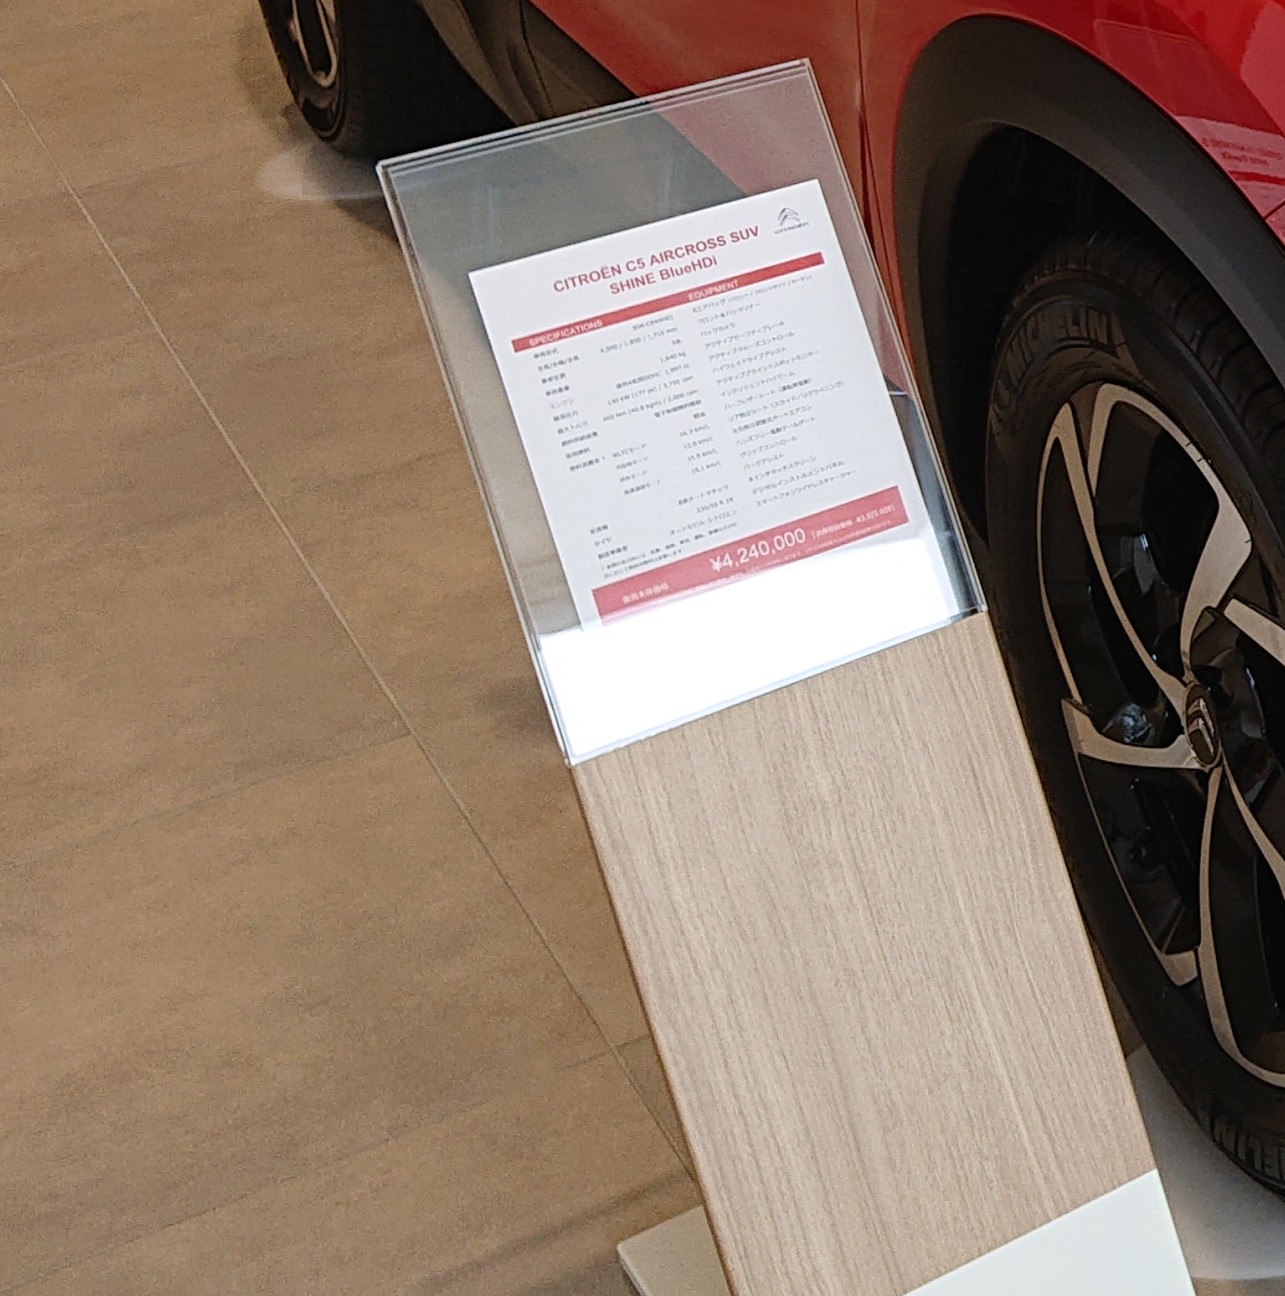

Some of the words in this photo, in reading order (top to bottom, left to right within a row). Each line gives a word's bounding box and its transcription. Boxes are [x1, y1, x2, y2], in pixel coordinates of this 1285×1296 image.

[551, 261, 622, 292] CITROËN
[624, 256, 646, 272] C5
[647, 234, 726, 266] AIRCROSS
[728, 225, 760, 243] SUV
[608, 271, 657, 295] SHINE
[658, 254, 718, 281] BlueHDi
[687, 279, 739, 301] EQUIPMENT
[527, 318, 604, 347] SPECIFICATIONS
[710, 528, 806, 572] ¥4,240,000
